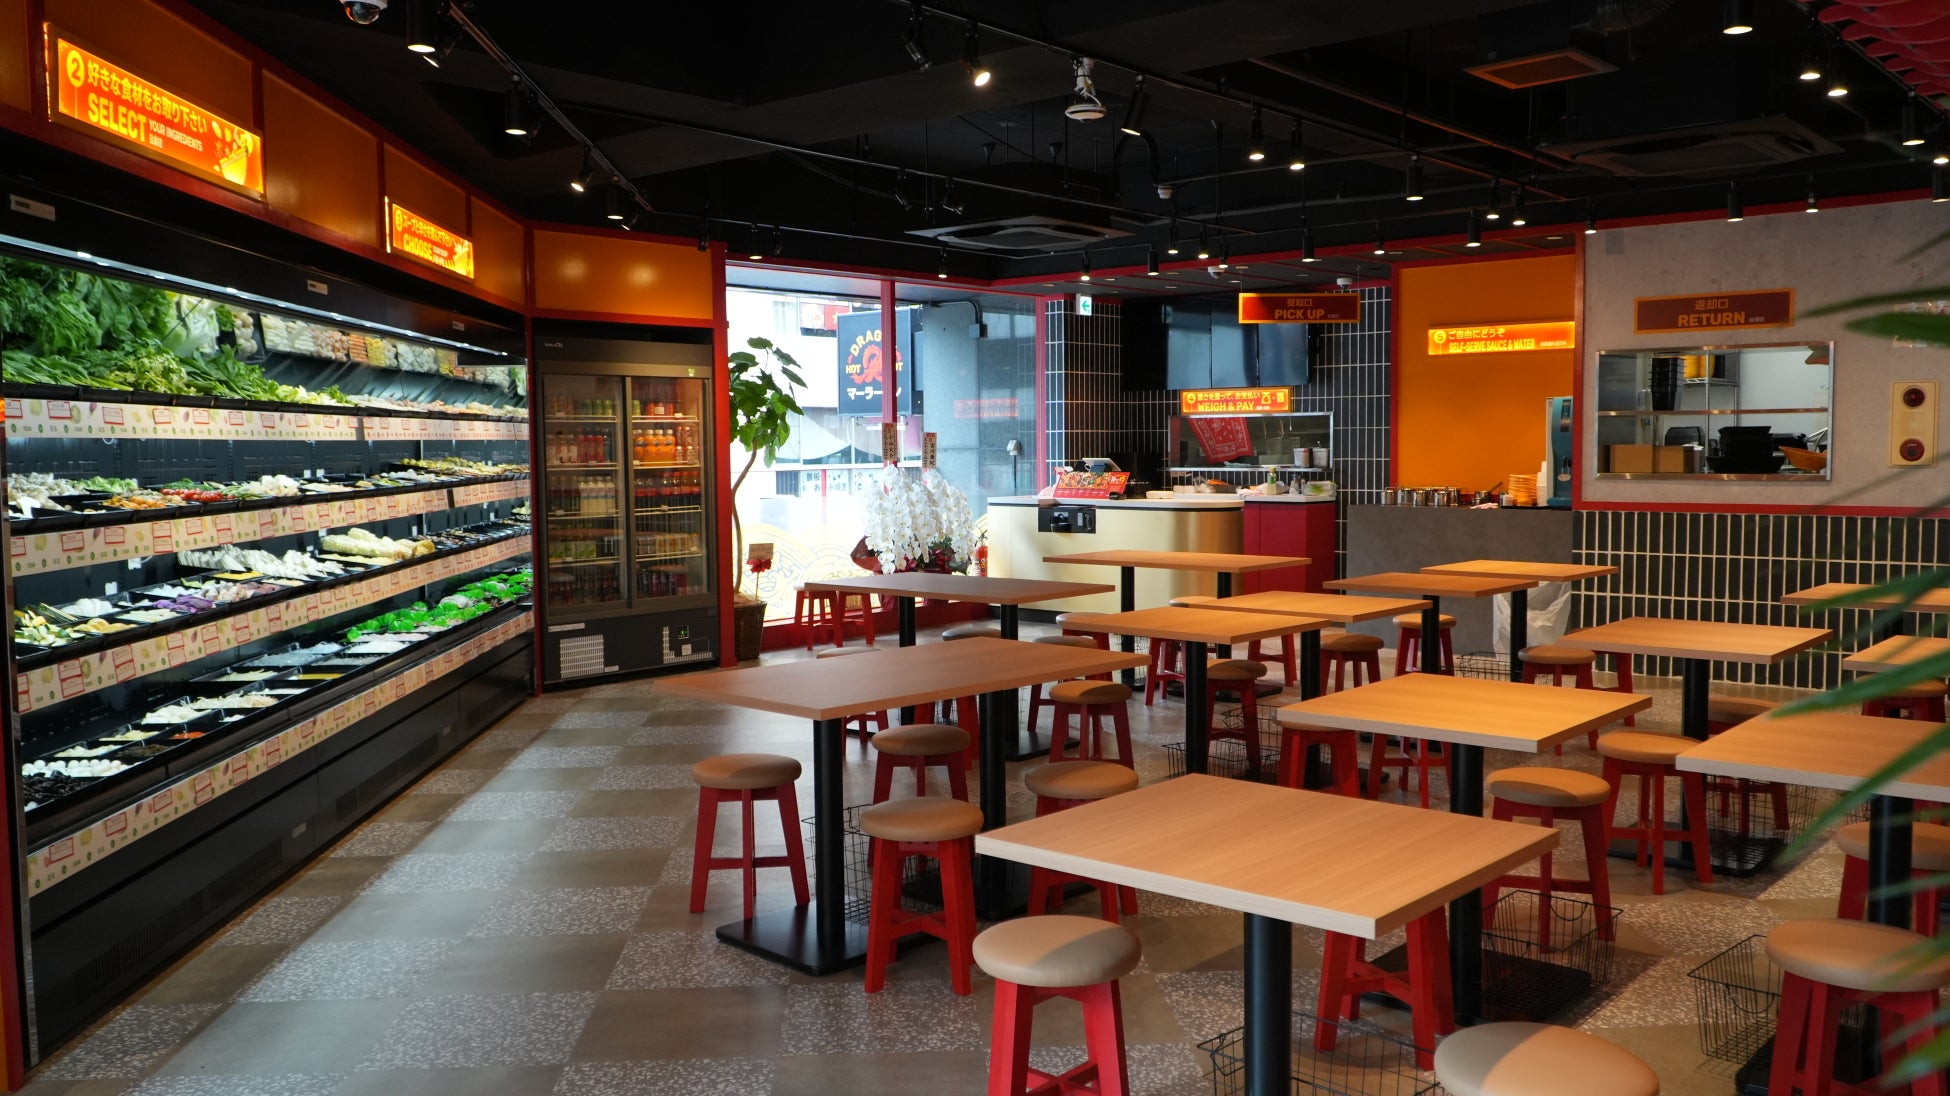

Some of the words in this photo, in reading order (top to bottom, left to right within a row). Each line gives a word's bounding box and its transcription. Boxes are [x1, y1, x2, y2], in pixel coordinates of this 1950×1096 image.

[87, 60, 207, 133] 好きな食材をお取り下さい
[88, 92, 147, 142] SELECT
[149, 119, 166, 136] YOUR
[166, 126, 203, 152] INGREDIENTS
[403, 233, 433, 262] CHOOSE
[1274, 309, 1304, 320] PICK
[1307, 309, 1325, 320] UP
[1677, 312, 1745, 327] RETURN
[1448, 328, 1506, 340] ご自由にどうぞ
[850, 329, 897, 357] DRAG
[1448, 341, 1486, 353] SELF-SERVE
[1486, 340, 1508, 351] SAUCE
[1513, 338, 1536, 350] WATER
[845, 364, 861, 374] HOT
[1197, 402, 1226, 412] WEIGH
[1227, 402, 1235, 411] &
[1236, 401, 1255, 411] PAY
